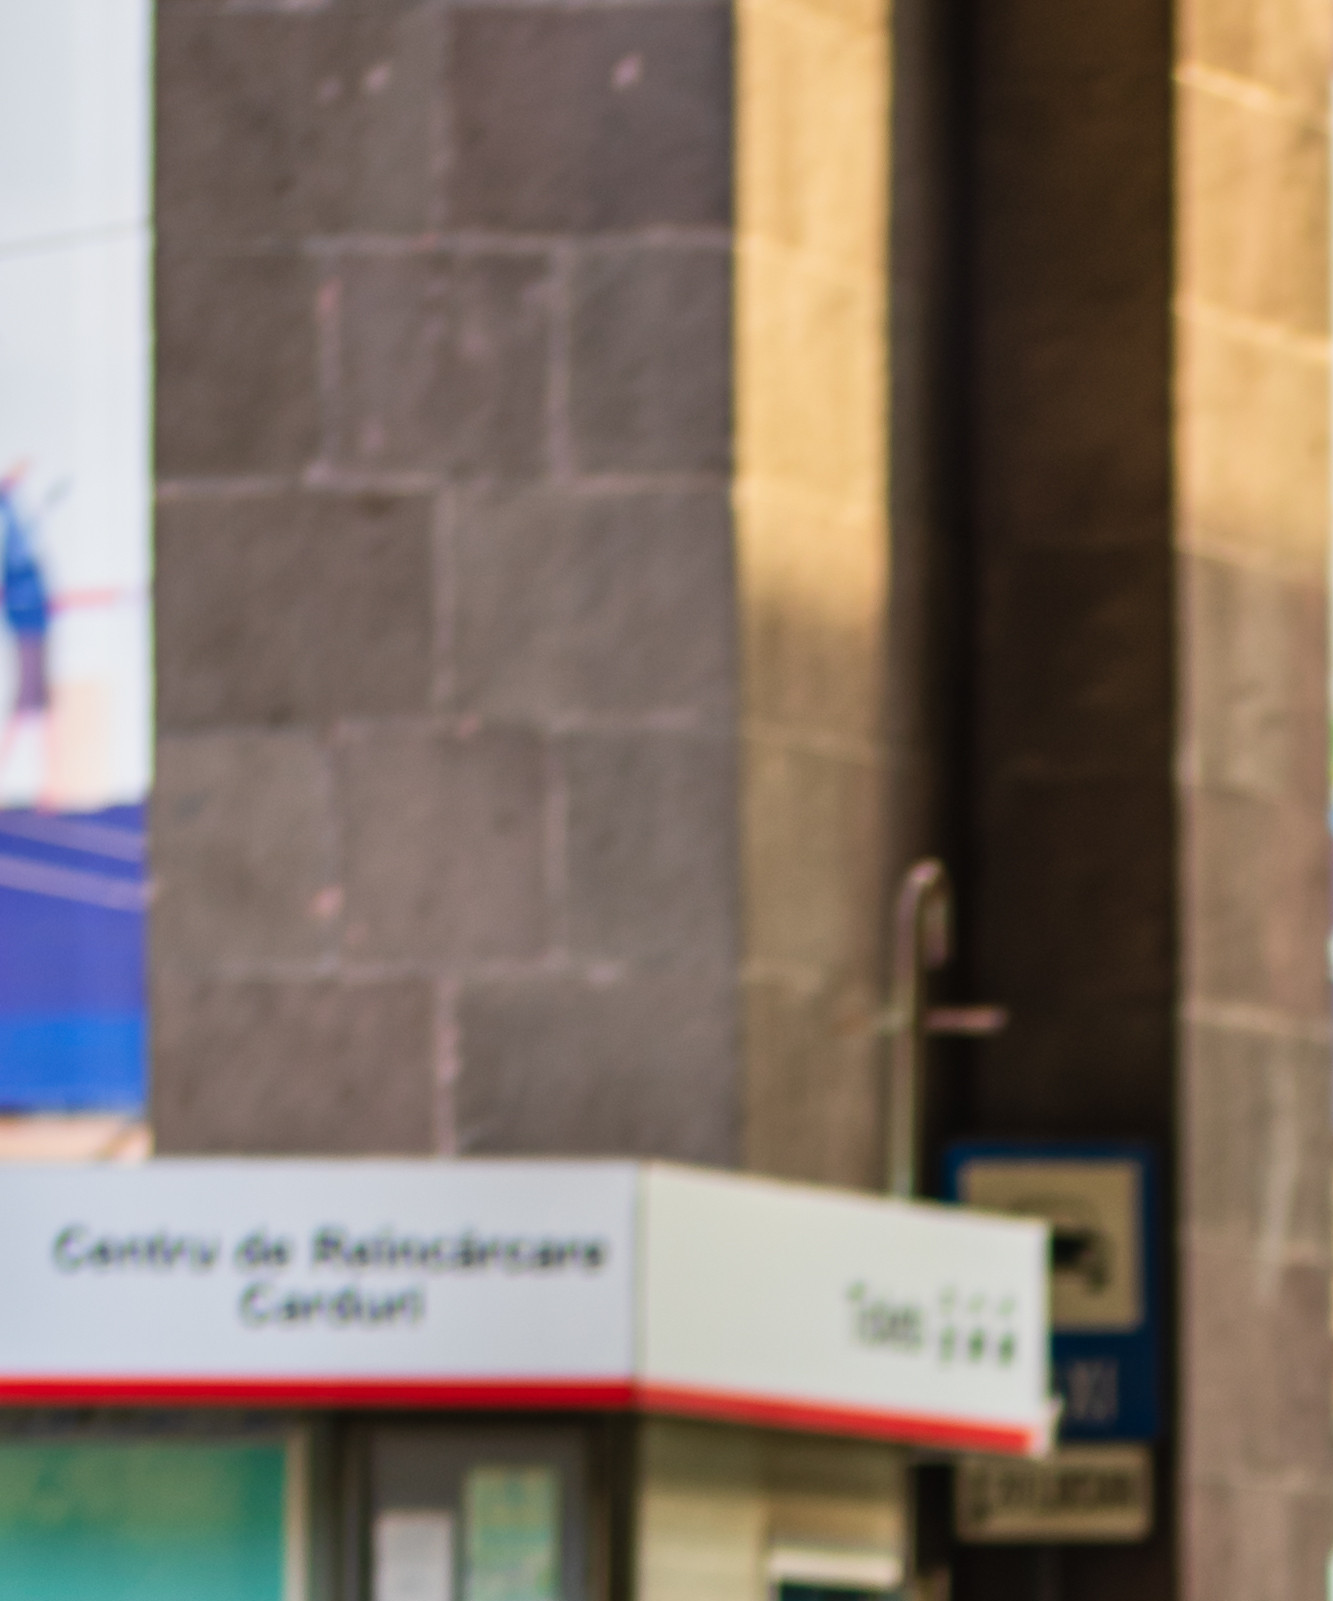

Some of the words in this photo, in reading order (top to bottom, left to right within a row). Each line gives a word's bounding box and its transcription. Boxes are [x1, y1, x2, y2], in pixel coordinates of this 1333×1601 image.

[52, 1224, 218, 1274] Centru
[234, 1228, 290, 1272] de
[237, 1281, 426, 1331] Carduri
